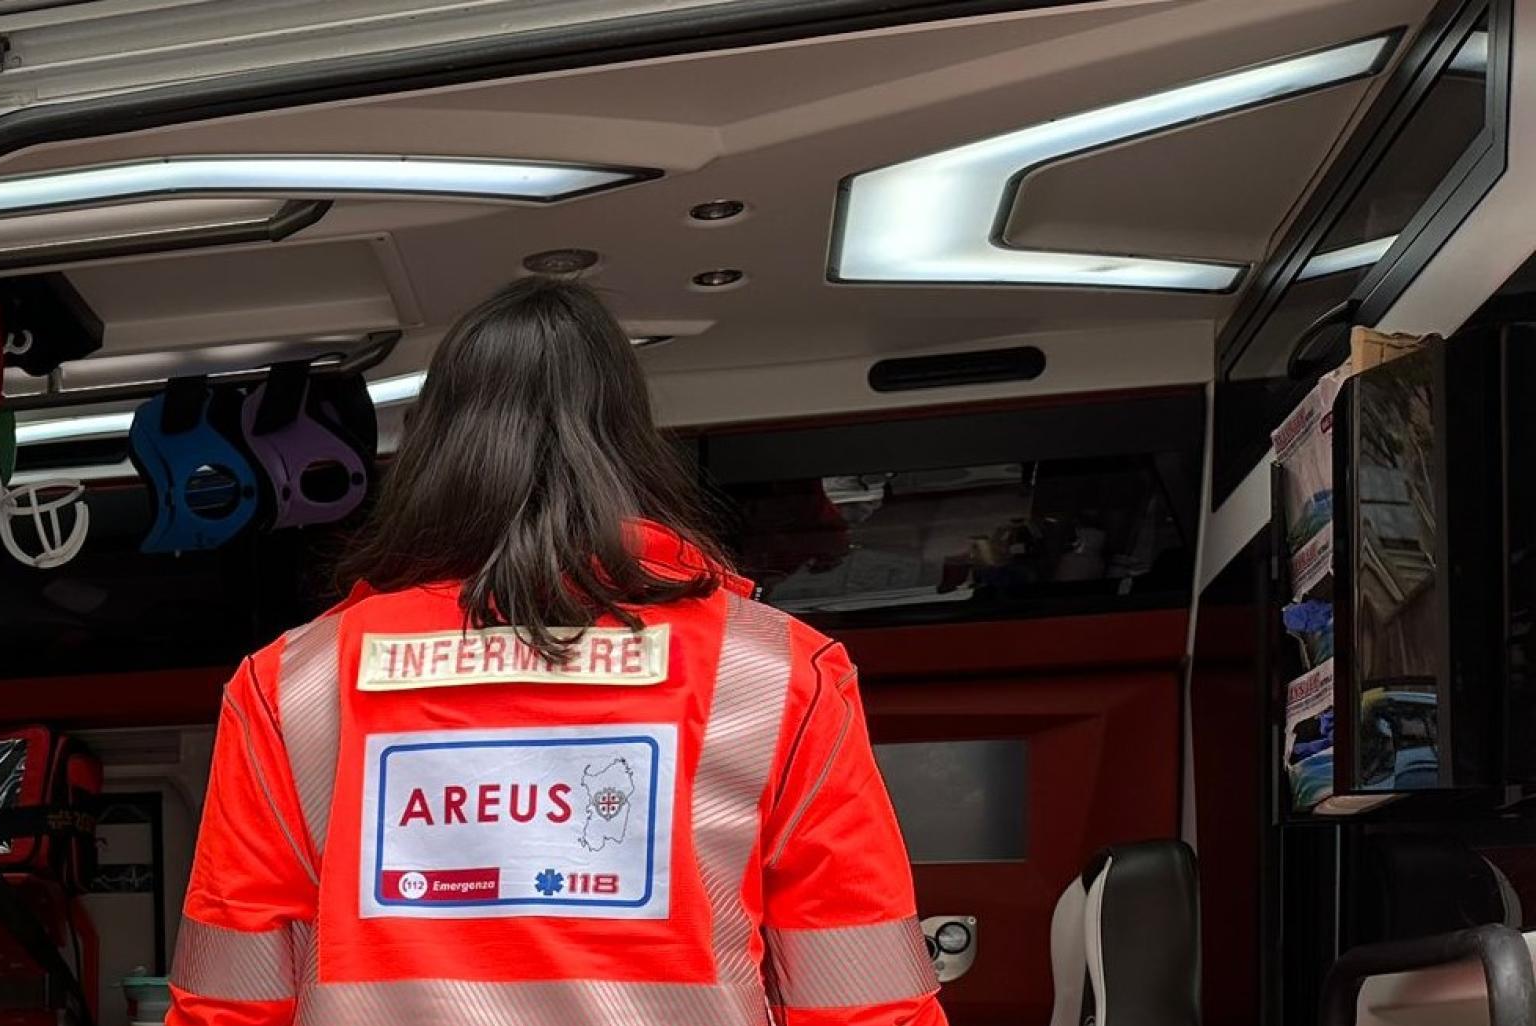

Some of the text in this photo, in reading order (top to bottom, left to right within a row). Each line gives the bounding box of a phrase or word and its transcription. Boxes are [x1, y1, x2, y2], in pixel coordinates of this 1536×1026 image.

[399, 783, 572, 826] AREUS
[433, 880, 496, 892] Emergenza
[567, 873, 619, 894] 118
